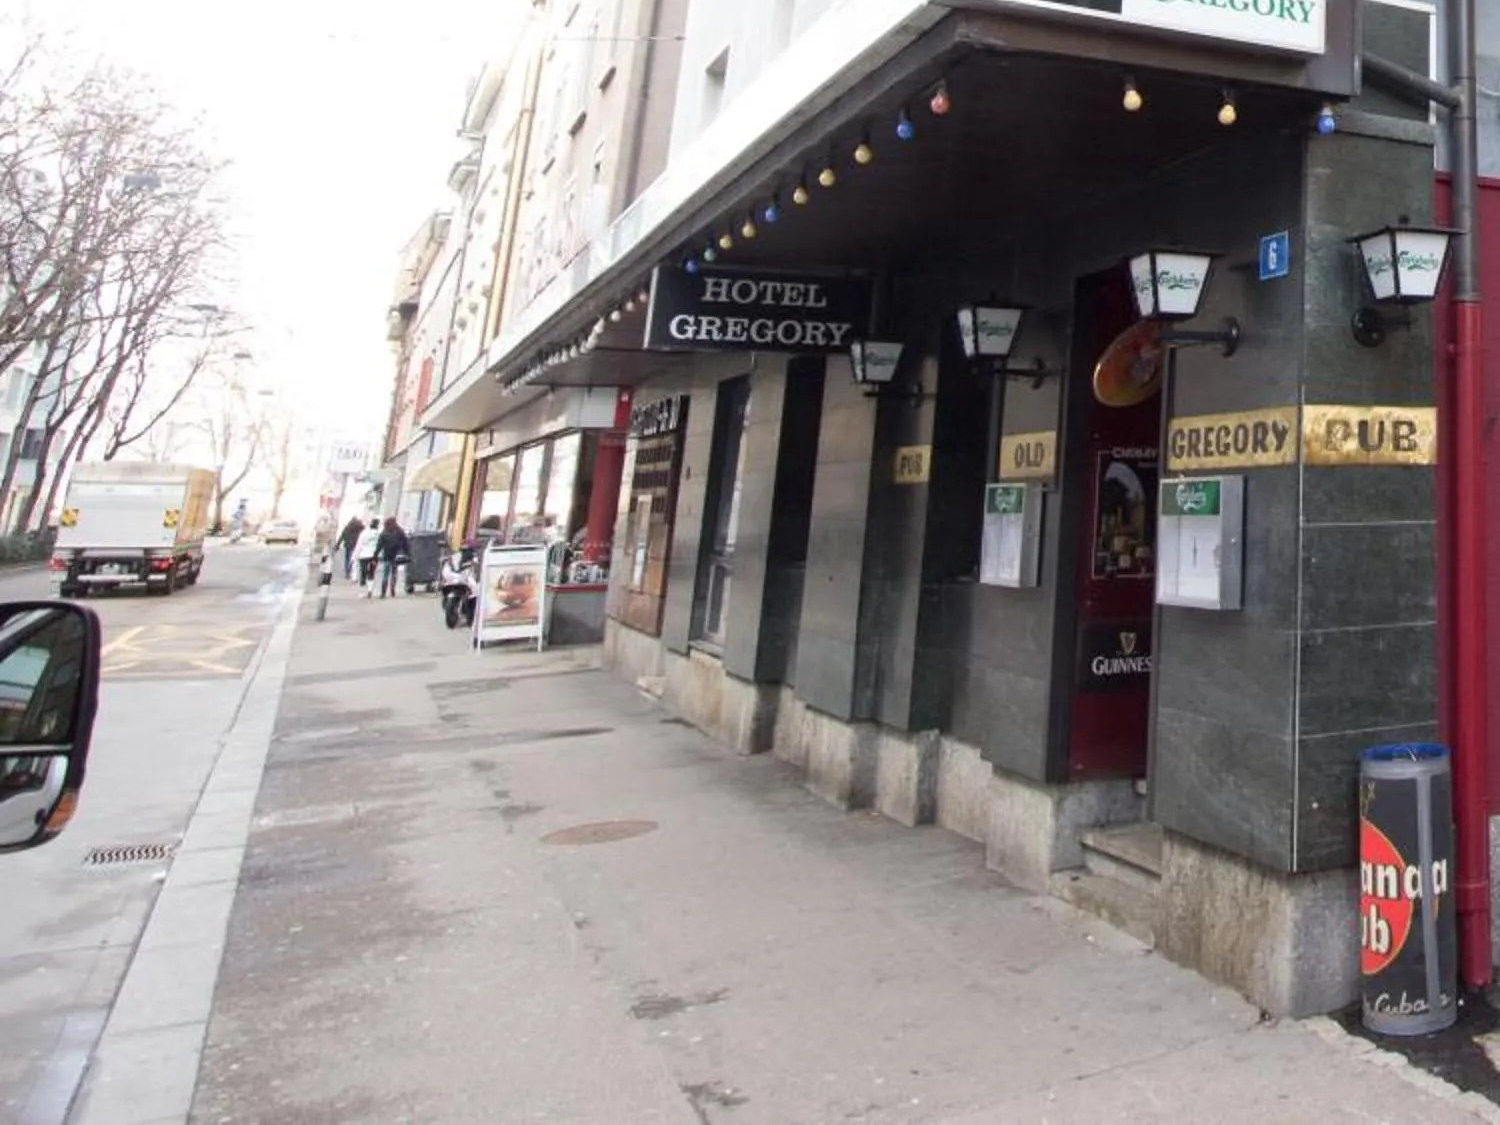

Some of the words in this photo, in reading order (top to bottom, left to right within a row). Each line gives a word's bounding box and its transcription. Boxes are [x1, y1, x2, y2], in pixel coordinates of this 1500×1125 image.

[1268, 240, 1278, 271] 6
[701, 277, 828, 308] HOTEL
[668, 314, 852, 346] GREGORY
[1014, 442, 1045, 468] OLD
[1171, 421, 1288, 460] GREGORY
[1324, 419, 1418, 452] PUB
[1091, 655, 1153, 676] GUINNES
